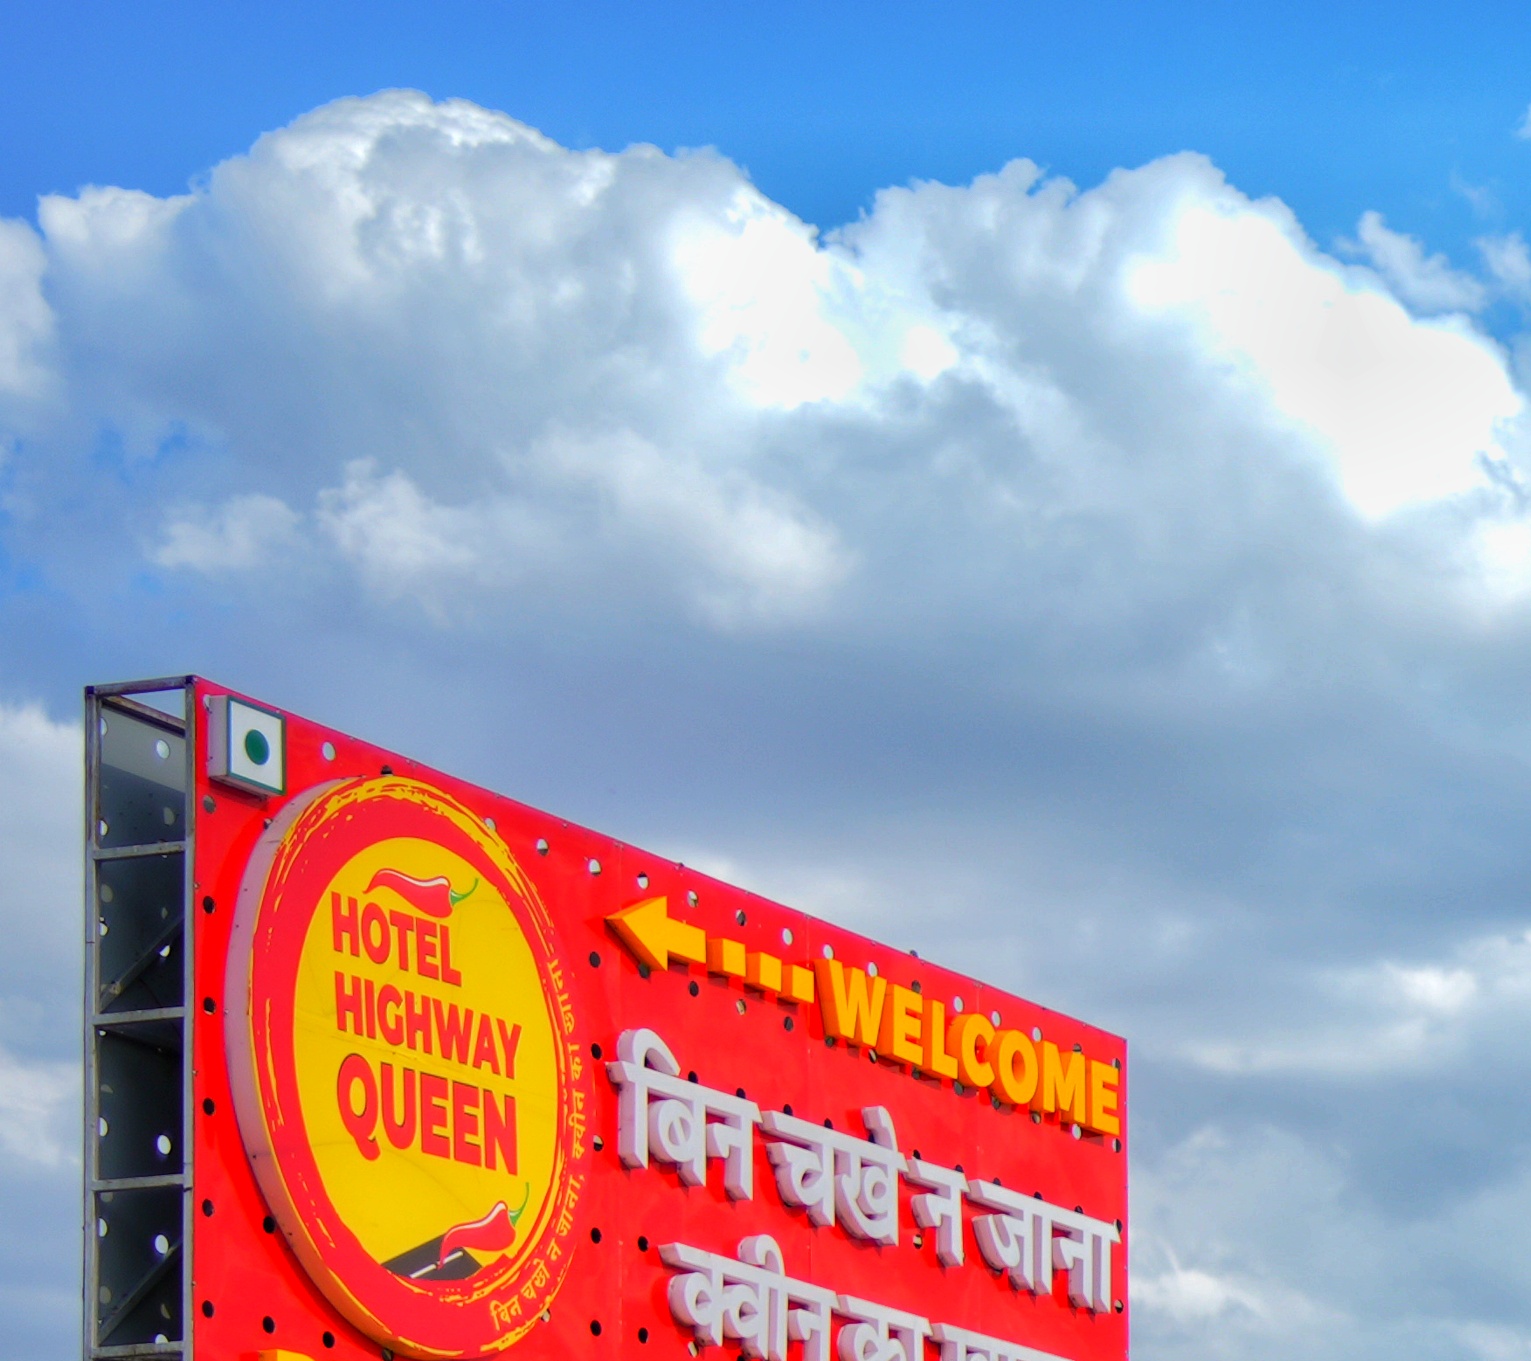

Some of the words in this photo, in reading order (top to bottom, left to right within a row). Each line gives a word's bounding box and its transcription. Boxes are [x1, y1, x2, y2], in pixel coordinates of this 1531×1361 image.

[331, 892, 461, 987] HOTEL
[334, 972, 522, 1079] HIGHWAY
[814, 959, 1119, 1135] WELCOME
[337, 1052, 518, 1176] QUEEN
[606, 1028, 762, 1201] बिन
[760, 1106, 908, 1246] चखे
[906, 1157, 969, 1267] न
[968, 1179, 1120, 1314] जाना
